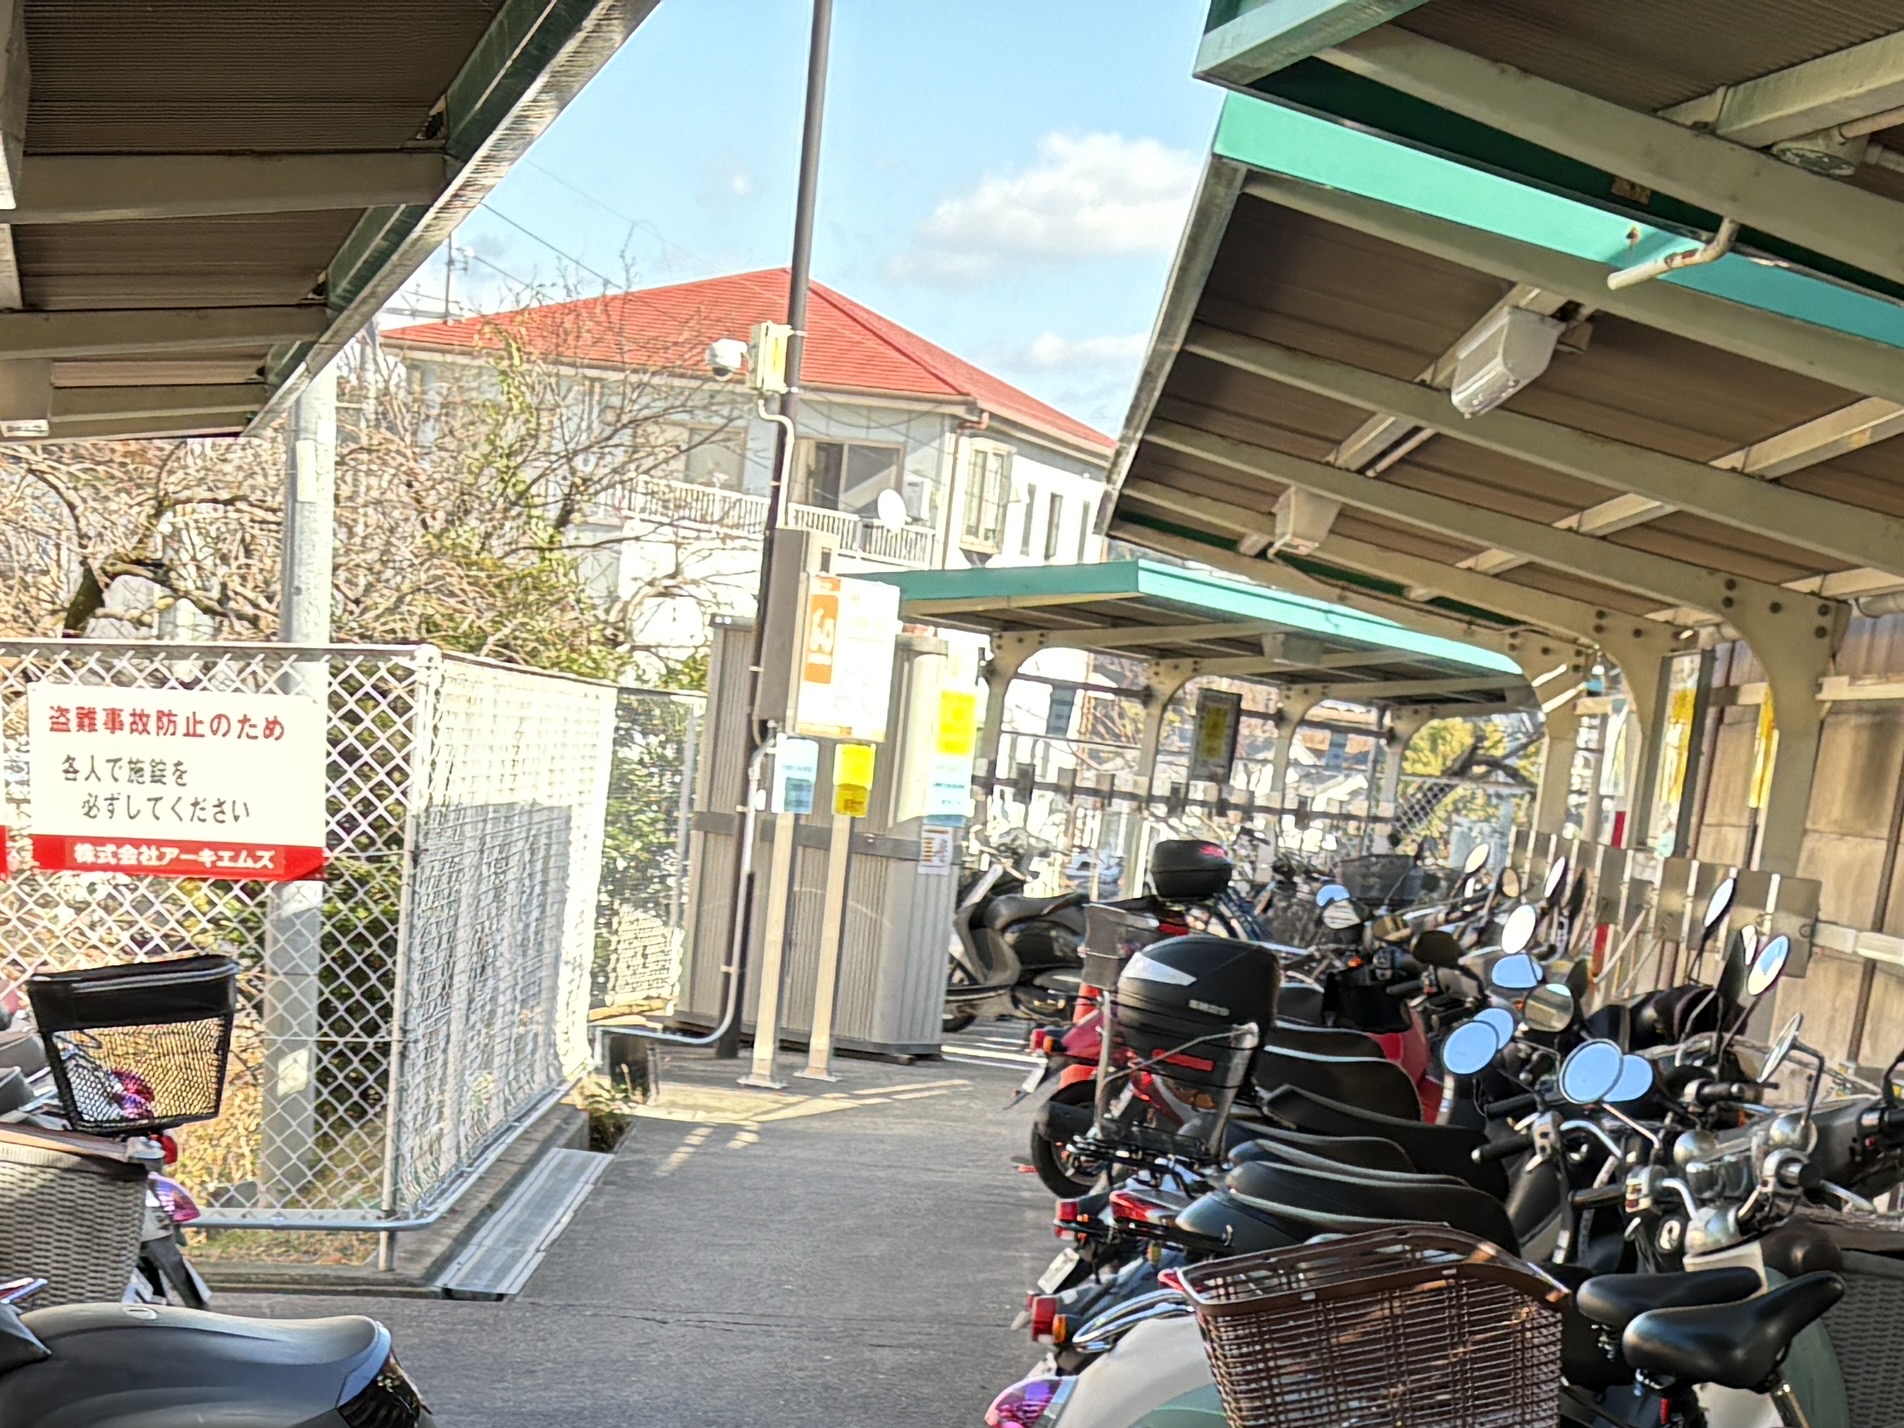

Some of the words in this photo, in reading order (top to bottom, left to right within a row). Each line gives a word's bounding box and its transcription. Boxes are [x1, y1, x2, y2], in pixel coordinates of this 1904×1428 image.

[48, 704, 286, 741] 盗難事故防止のため
[60, 754, 189, 787] 各人で施錠を
[81, 791, 251, 824] 必ずしてください
[73, 842, 277, 869] 株式会社アーキエムズ
